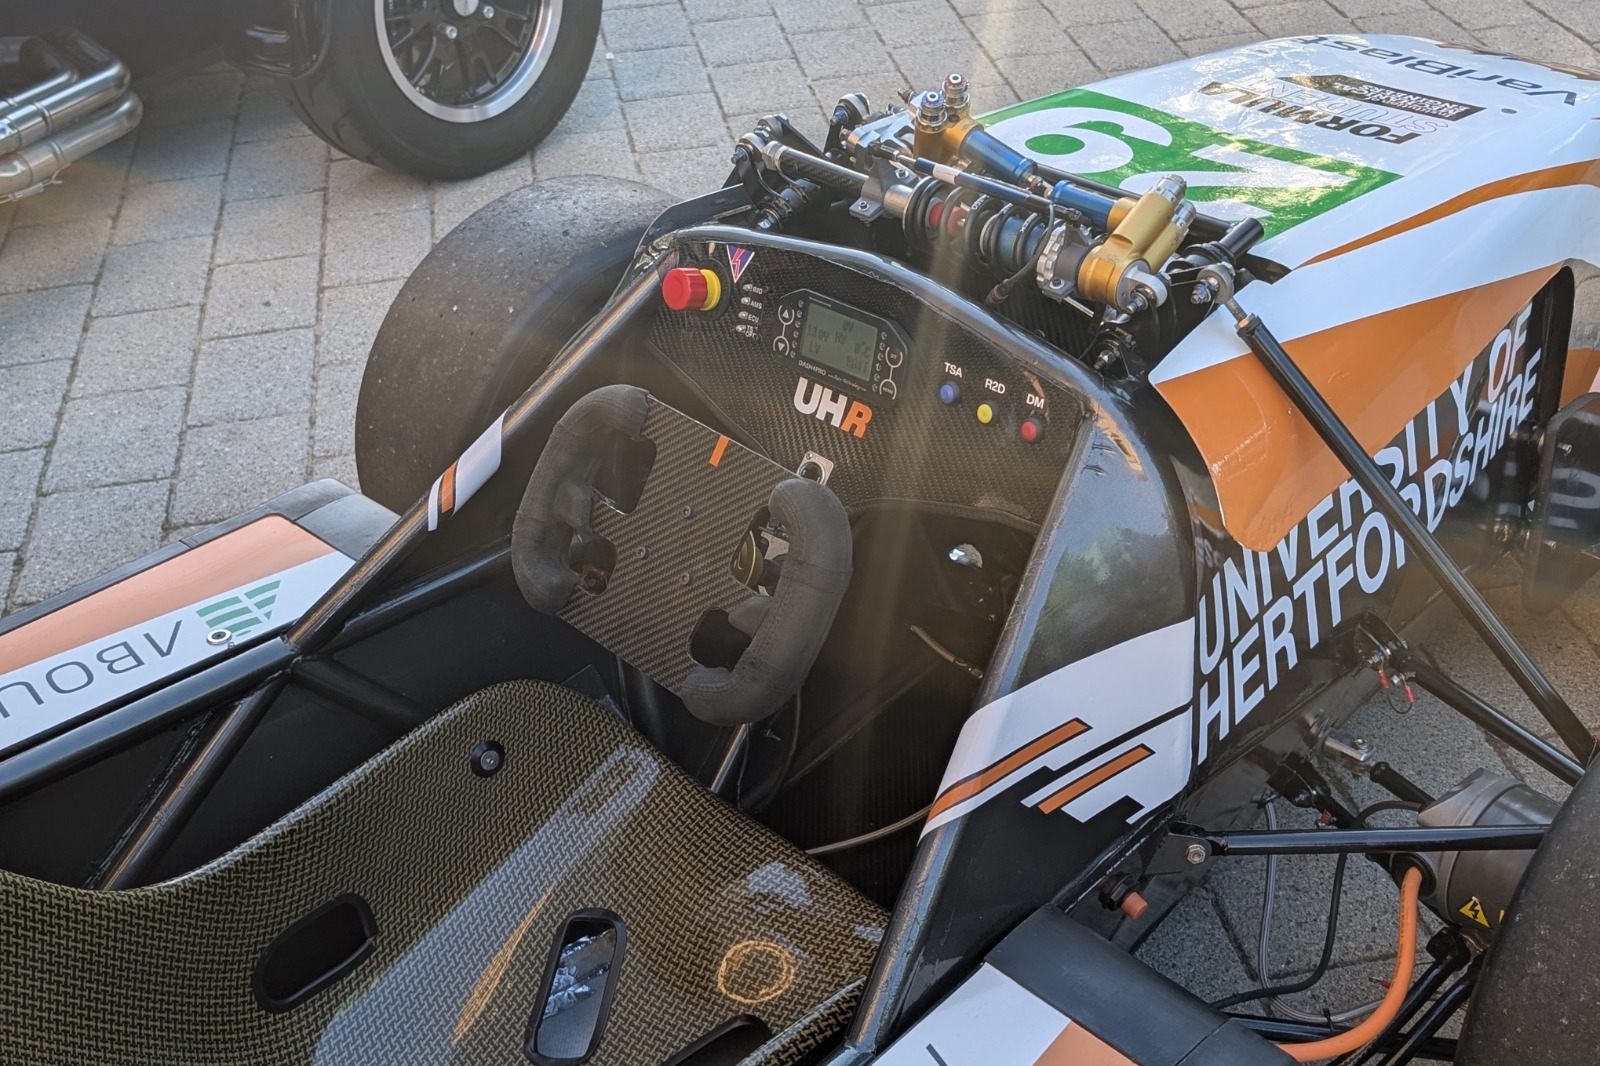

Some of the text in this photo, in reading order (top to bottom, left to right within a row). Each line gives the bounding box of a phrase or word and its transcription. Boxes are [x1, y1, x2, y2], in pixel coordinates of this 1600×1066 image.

[1299, 35, 1578, 107] VariBlast
[1196, 81, 1422, 145] FORMULA
[750, 300, 763, 310] AMS
[747, 313, 760, 323] ECU
[1487, 302, 1533, 404] OF
[944, 361, 963, 378] TSA
[984, 378, 1006, 395] R2D
[793, 376, 873, 439] UHR
[1026, 393, 1045, 410] DM
